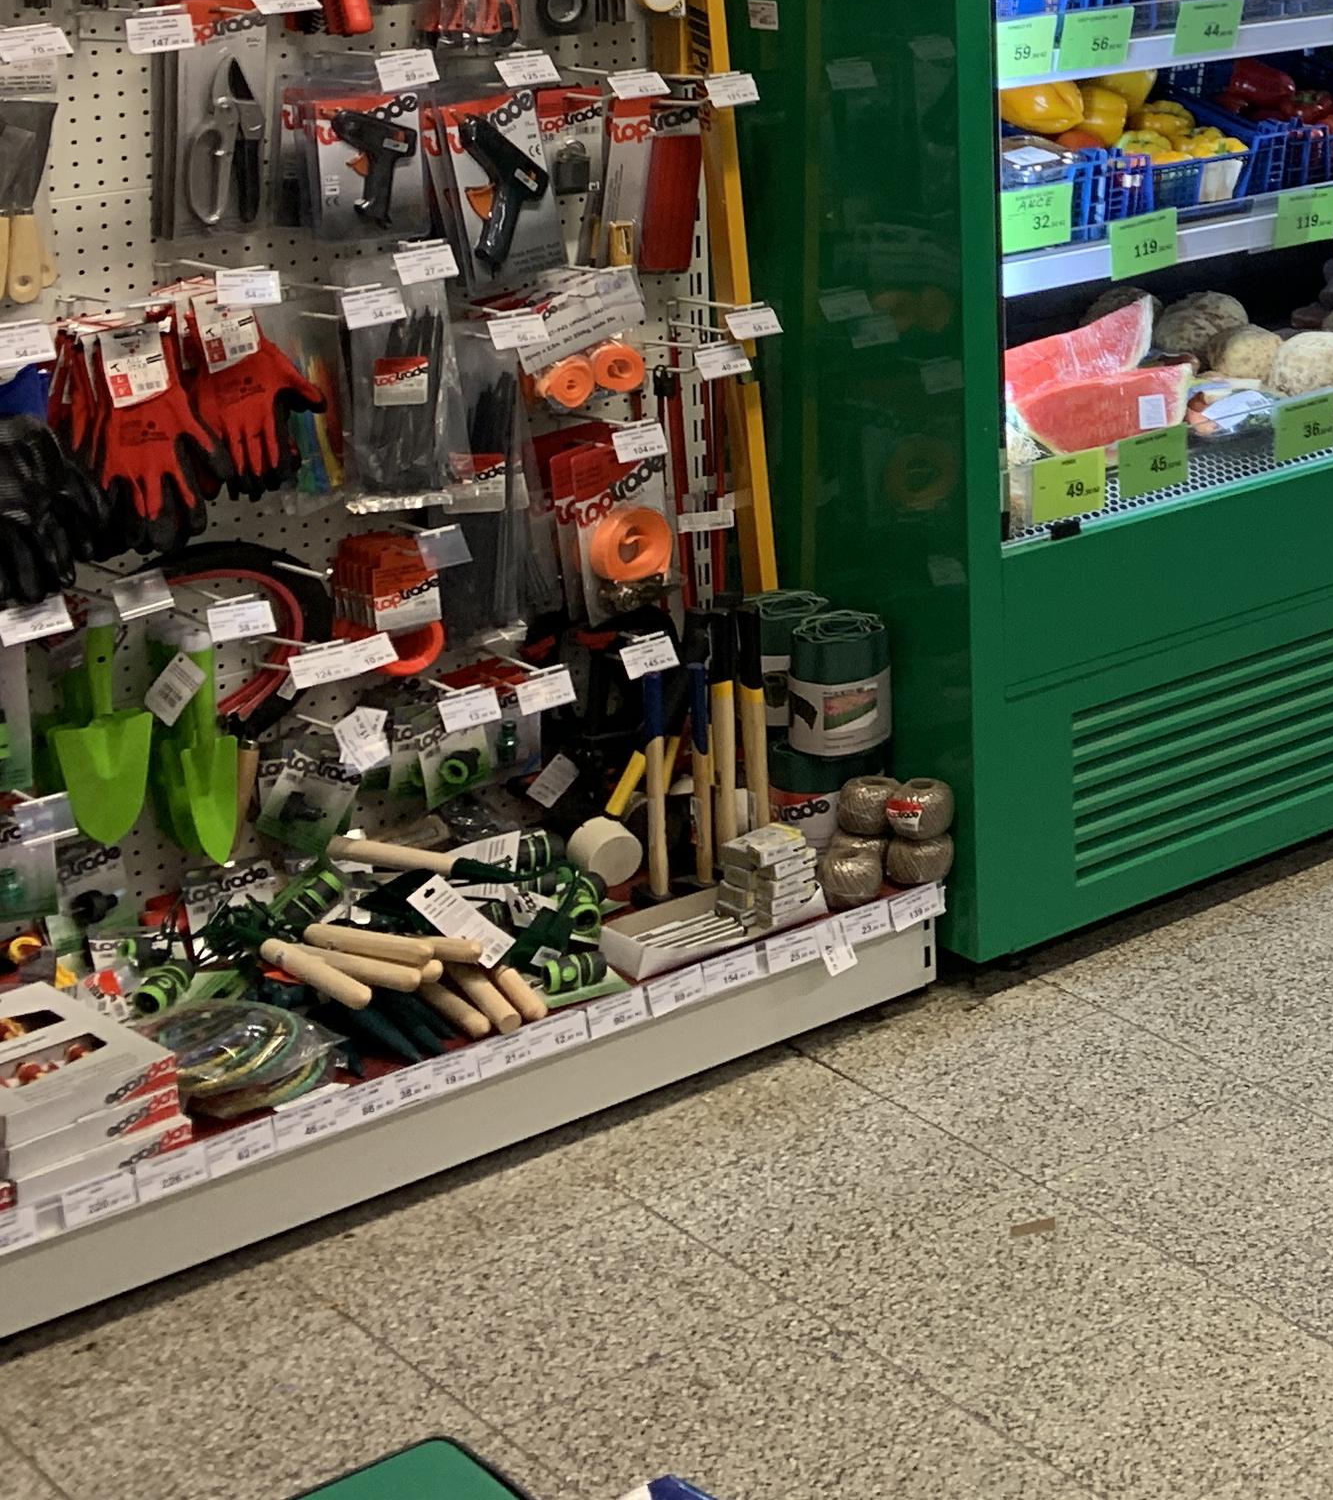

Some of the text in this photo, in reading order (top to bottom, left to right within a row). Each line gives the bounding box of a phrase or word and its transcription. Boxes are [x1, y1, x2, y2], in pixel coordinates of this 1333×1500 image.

[1203, 23, 1221, 37] 44
[1091, 37, 1110, 51] 56
[1014, 46, 1032, 60] 59
[1033, 215, 1050, 230] 32
[1133, 242, 1159, 258] 119
[1303, 422, 1320, 438] 36
[1150, 456, 1168, 473] 45
[1066, 482, 1085, 498] 49
